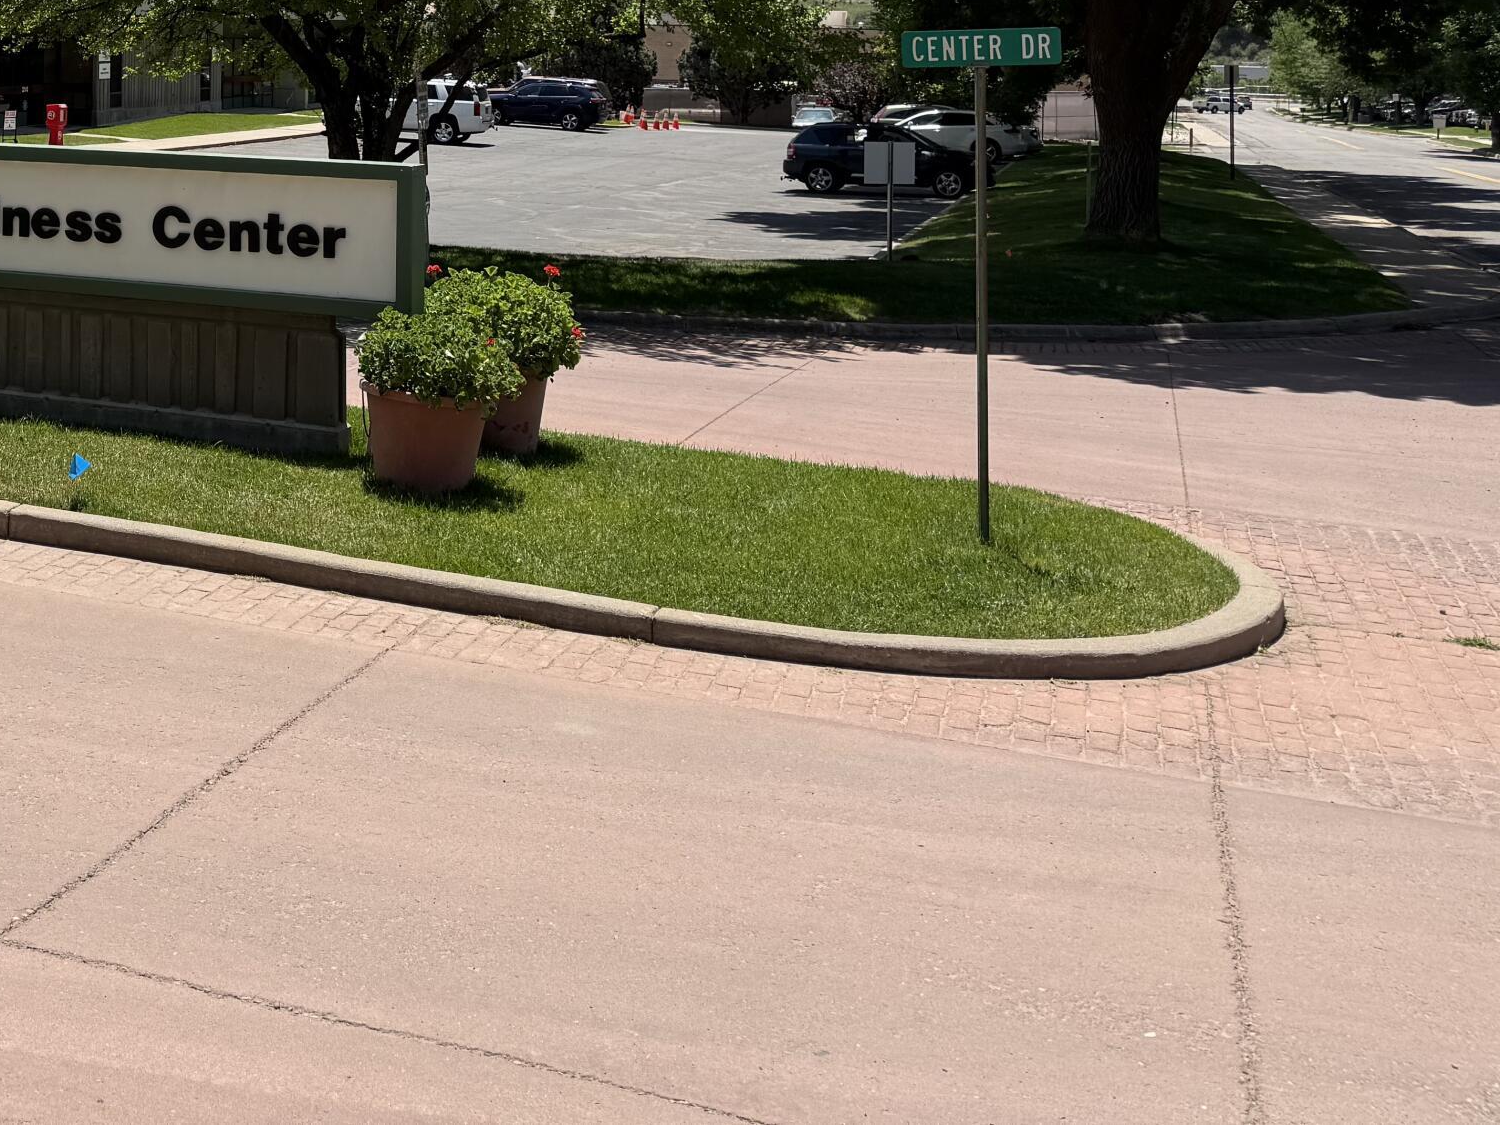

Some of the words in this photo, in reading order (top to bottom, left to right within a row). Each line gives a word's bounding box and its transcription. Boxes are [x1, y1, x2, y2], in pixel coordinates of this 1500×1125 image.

[911, 35, 1002, 62] CENTER
[1021, 33, 1051, 60] DR
[152, 205, 347, 259] Center
